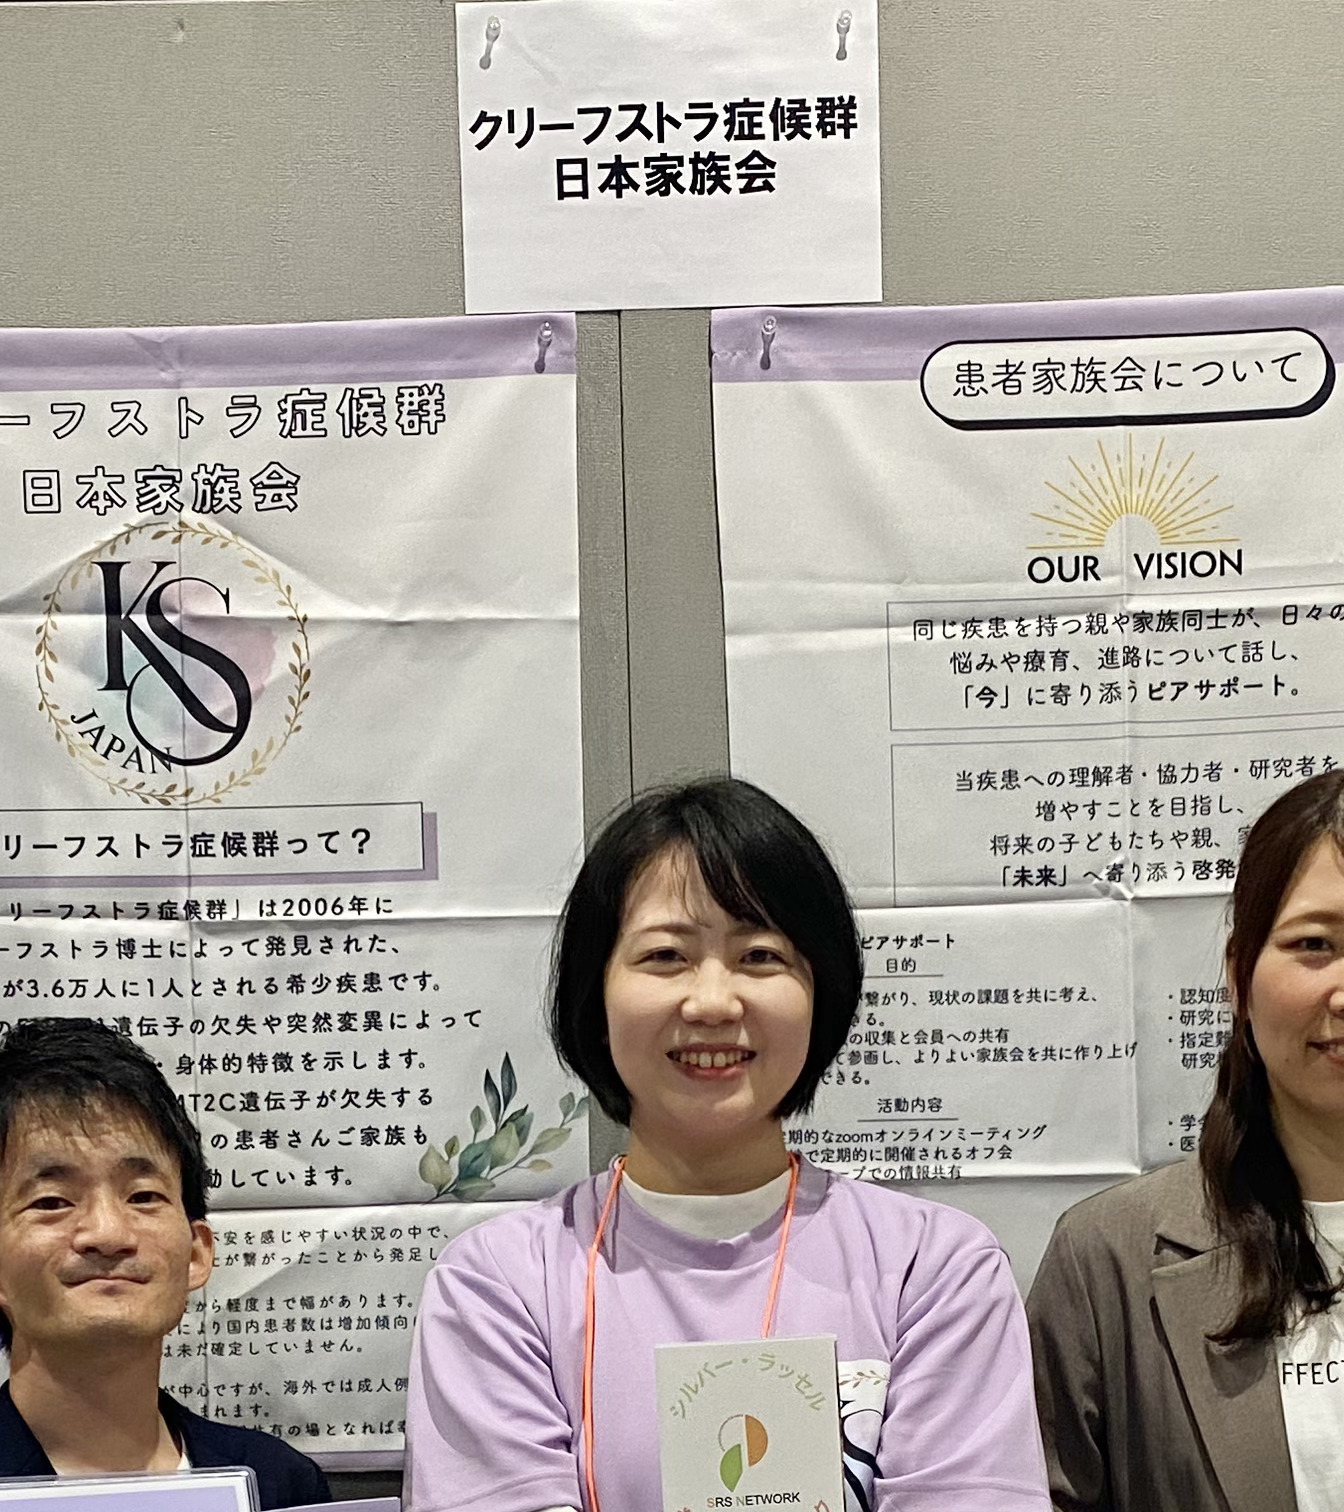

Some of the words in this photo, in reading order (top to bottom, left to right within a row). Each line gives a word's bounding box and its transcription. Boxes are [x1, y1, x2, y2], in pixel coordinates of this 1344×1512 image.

[469, 94, 858, 151] クリーフストラ症候群
[556, 150, 777, 200] 日本家族会
[952, 350, 1305, 398] 患者家族会について
[23, 462, 302, 515] 日本家族会
[1027, 554, 1102, 584] OUR
[1133, 550, 1243, 581] VISION
[92, 561, 252, 766] KS
[71, 708, 173, 774] JAPAN
[1036, 795, 1245, 821] 増やすことを目指し、
[861, 934, 956, 950] ピアサポート
[886, 958, 917, 973] 目的
[877, 1098, 943, 1113] 活動内容
[669, 1352, 827, 1419] シルバー・ラッセル
[707, 1496, 732, 1508] SRS
[736, 1492, 800, 1507] NETWORK
